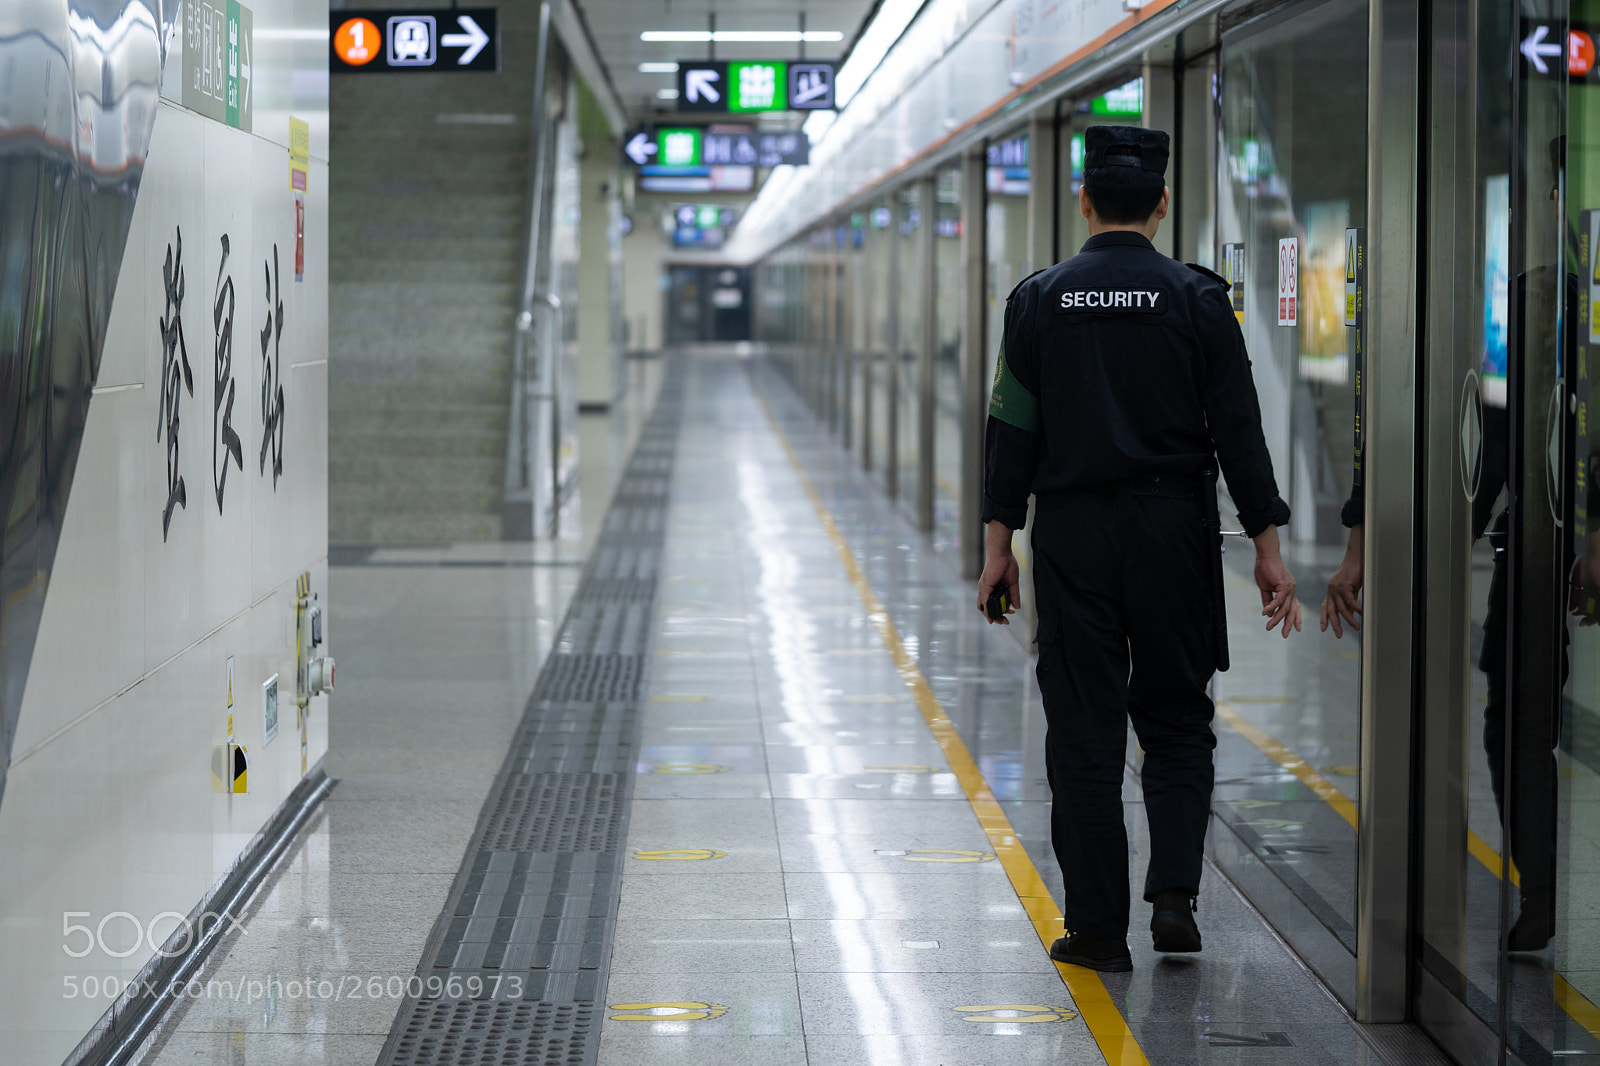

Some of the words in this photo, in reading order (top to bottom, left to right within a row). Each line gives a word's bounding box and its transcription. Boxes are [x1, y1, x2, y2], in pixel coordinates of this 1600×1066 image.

[228, 17, 238, 78] 出
[349, 21, 364, 48] 1
[1060, 291, 1160, 308] SECURITY
